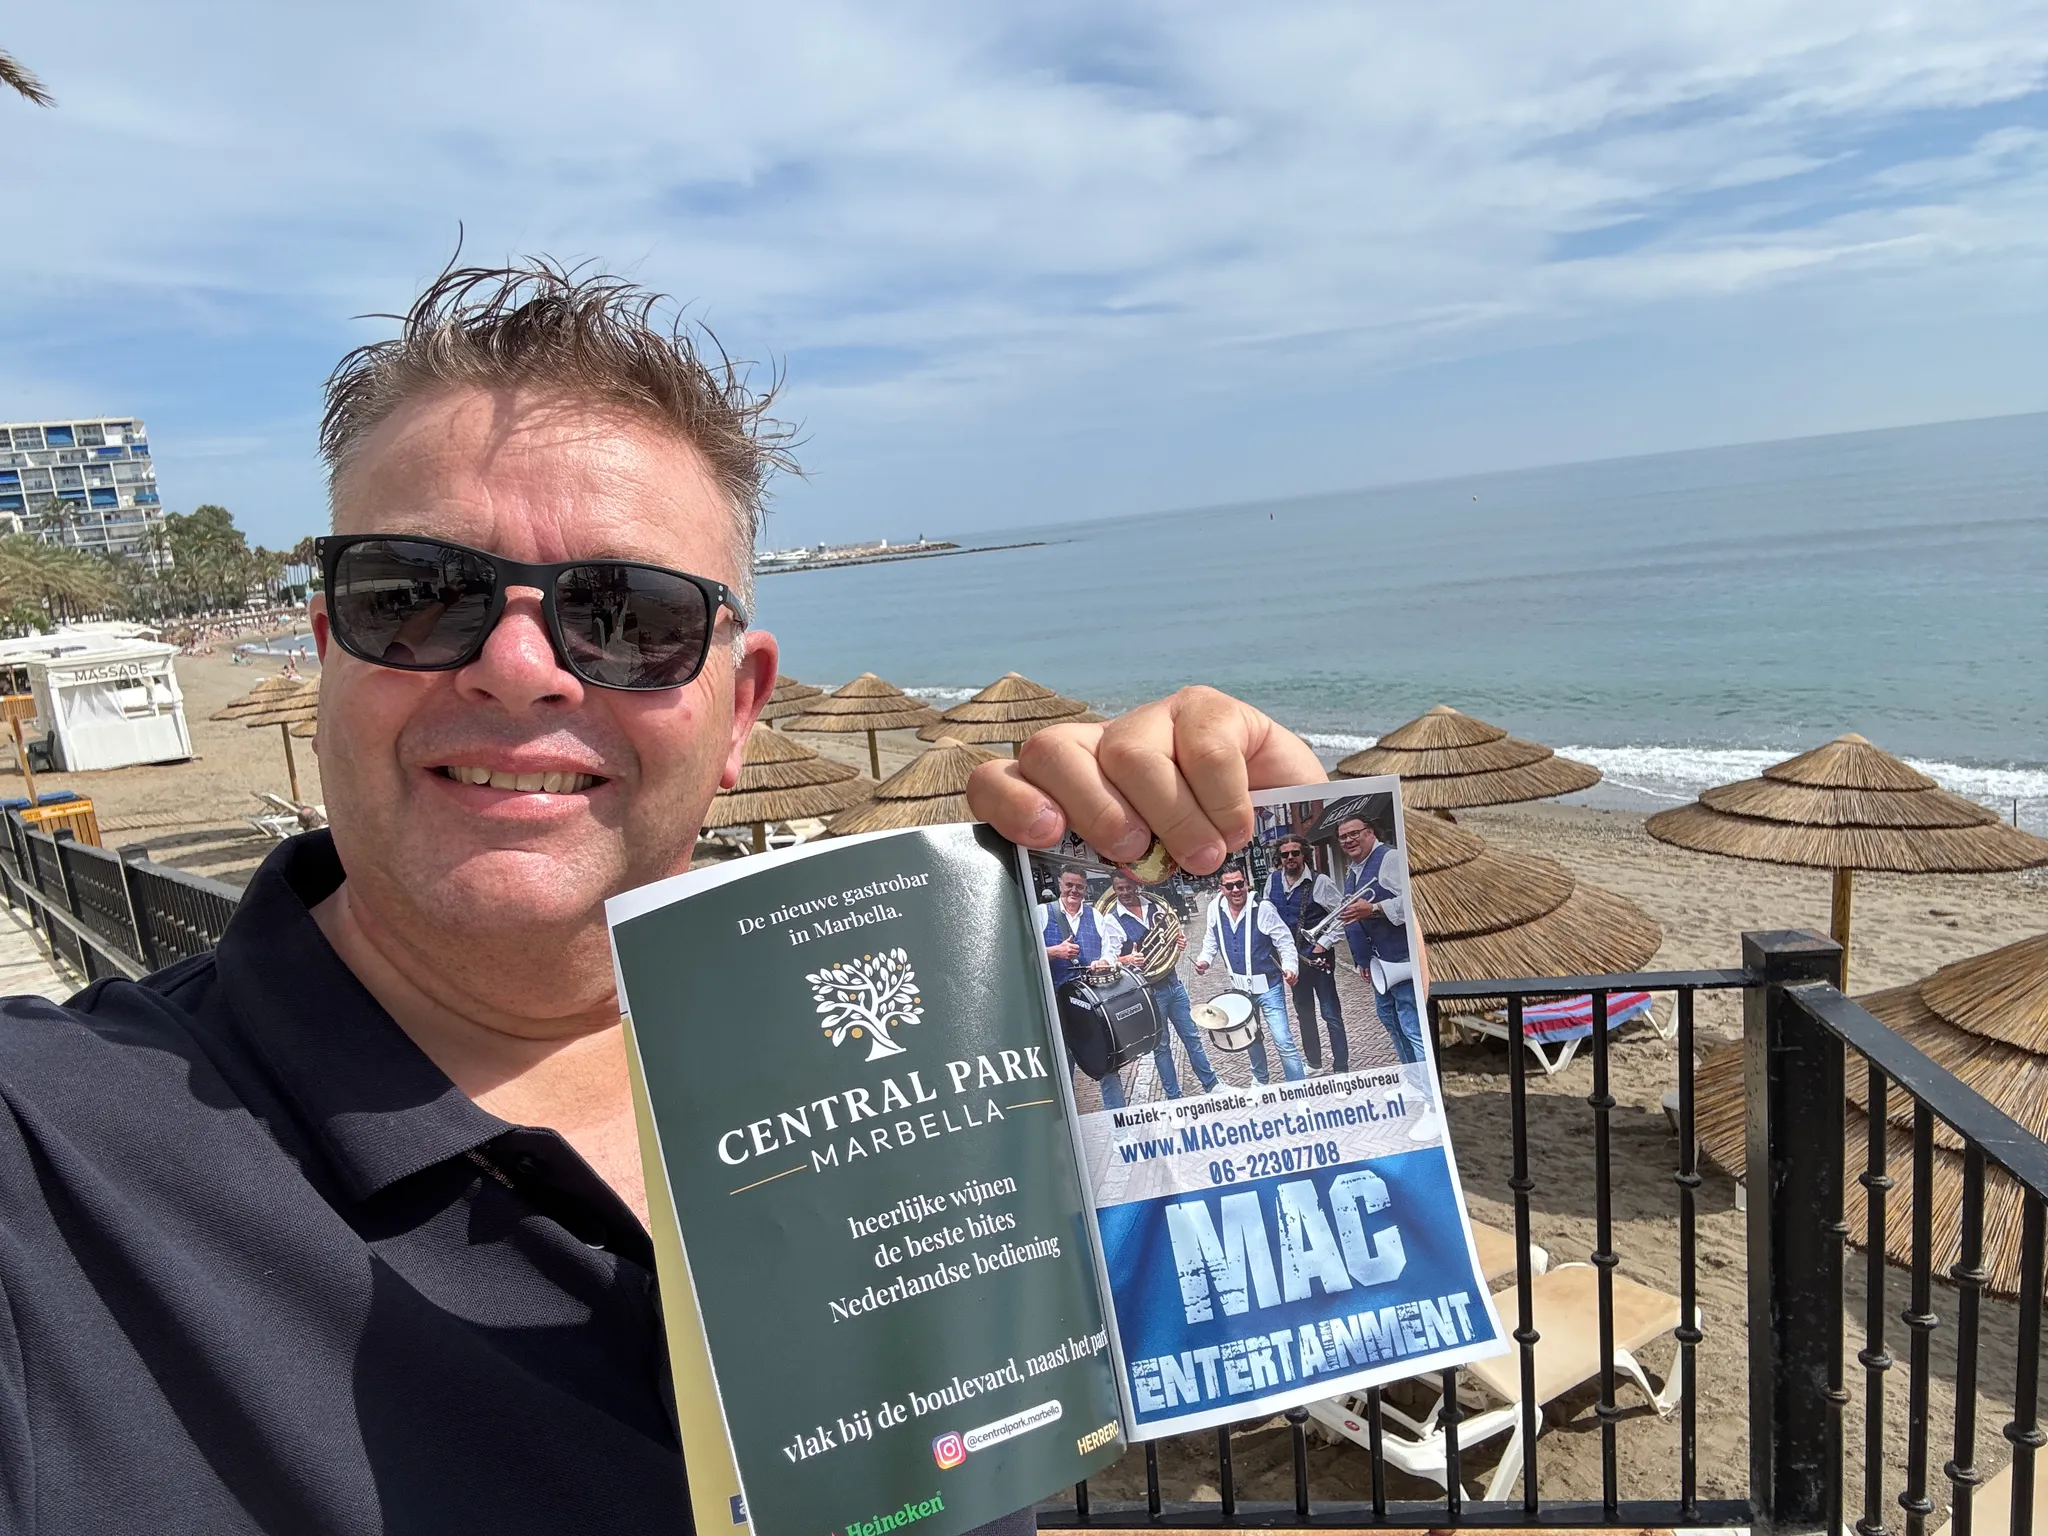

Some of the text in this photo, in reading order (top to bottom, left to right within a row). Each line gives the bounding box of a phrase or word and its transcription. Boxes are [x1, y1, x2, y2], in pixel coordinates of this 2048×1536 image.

[737, 870, 930, 936] De nieuwe gastrobar
[788, 905, 903, 946] in Marbella.
[717, 1046, 1049, 1166] CENTRAL PARK
[1114, 1109, 1173, 1129] Muziek-,
[1262, 1091, 1278, 1105] en
[1280, 1072, 1400, 1103] bemiddelingsbureau
[1119, 1094, 1407, 1164] www.MACentertainment.nl
[810, 1098, 1005, 1173] MARBELLA
[1209, 1140, 1341, 1185] 06-22307708
[847, 1175, 1018, 1240] heerlijke wijnen
[874, 1212, 1016, 1268] de beste bites
[827, 1235, 1062, 1324] Nederlandse bediening
[1165, 1169, 1408, 1325] MAC
[1130, 1292, 1476, 1414] ENTERTAINMENT
[782, 1425, 838, 1464] vlak
[839, 1408, 874, 1446] bij
[877, 1401, 908, 1429] de
[908, 1358, 1025, 1417] boulevard,
[1025, 1343, 1071, 1378] naast
[1067, 1335, 1092, 1361] het
[966, 1405, 1060, 1449] @centralpark.marbella
[1076, 1419, 1120, 1456] HERRERO
[845, 1496, 945, 1536] Heineken
